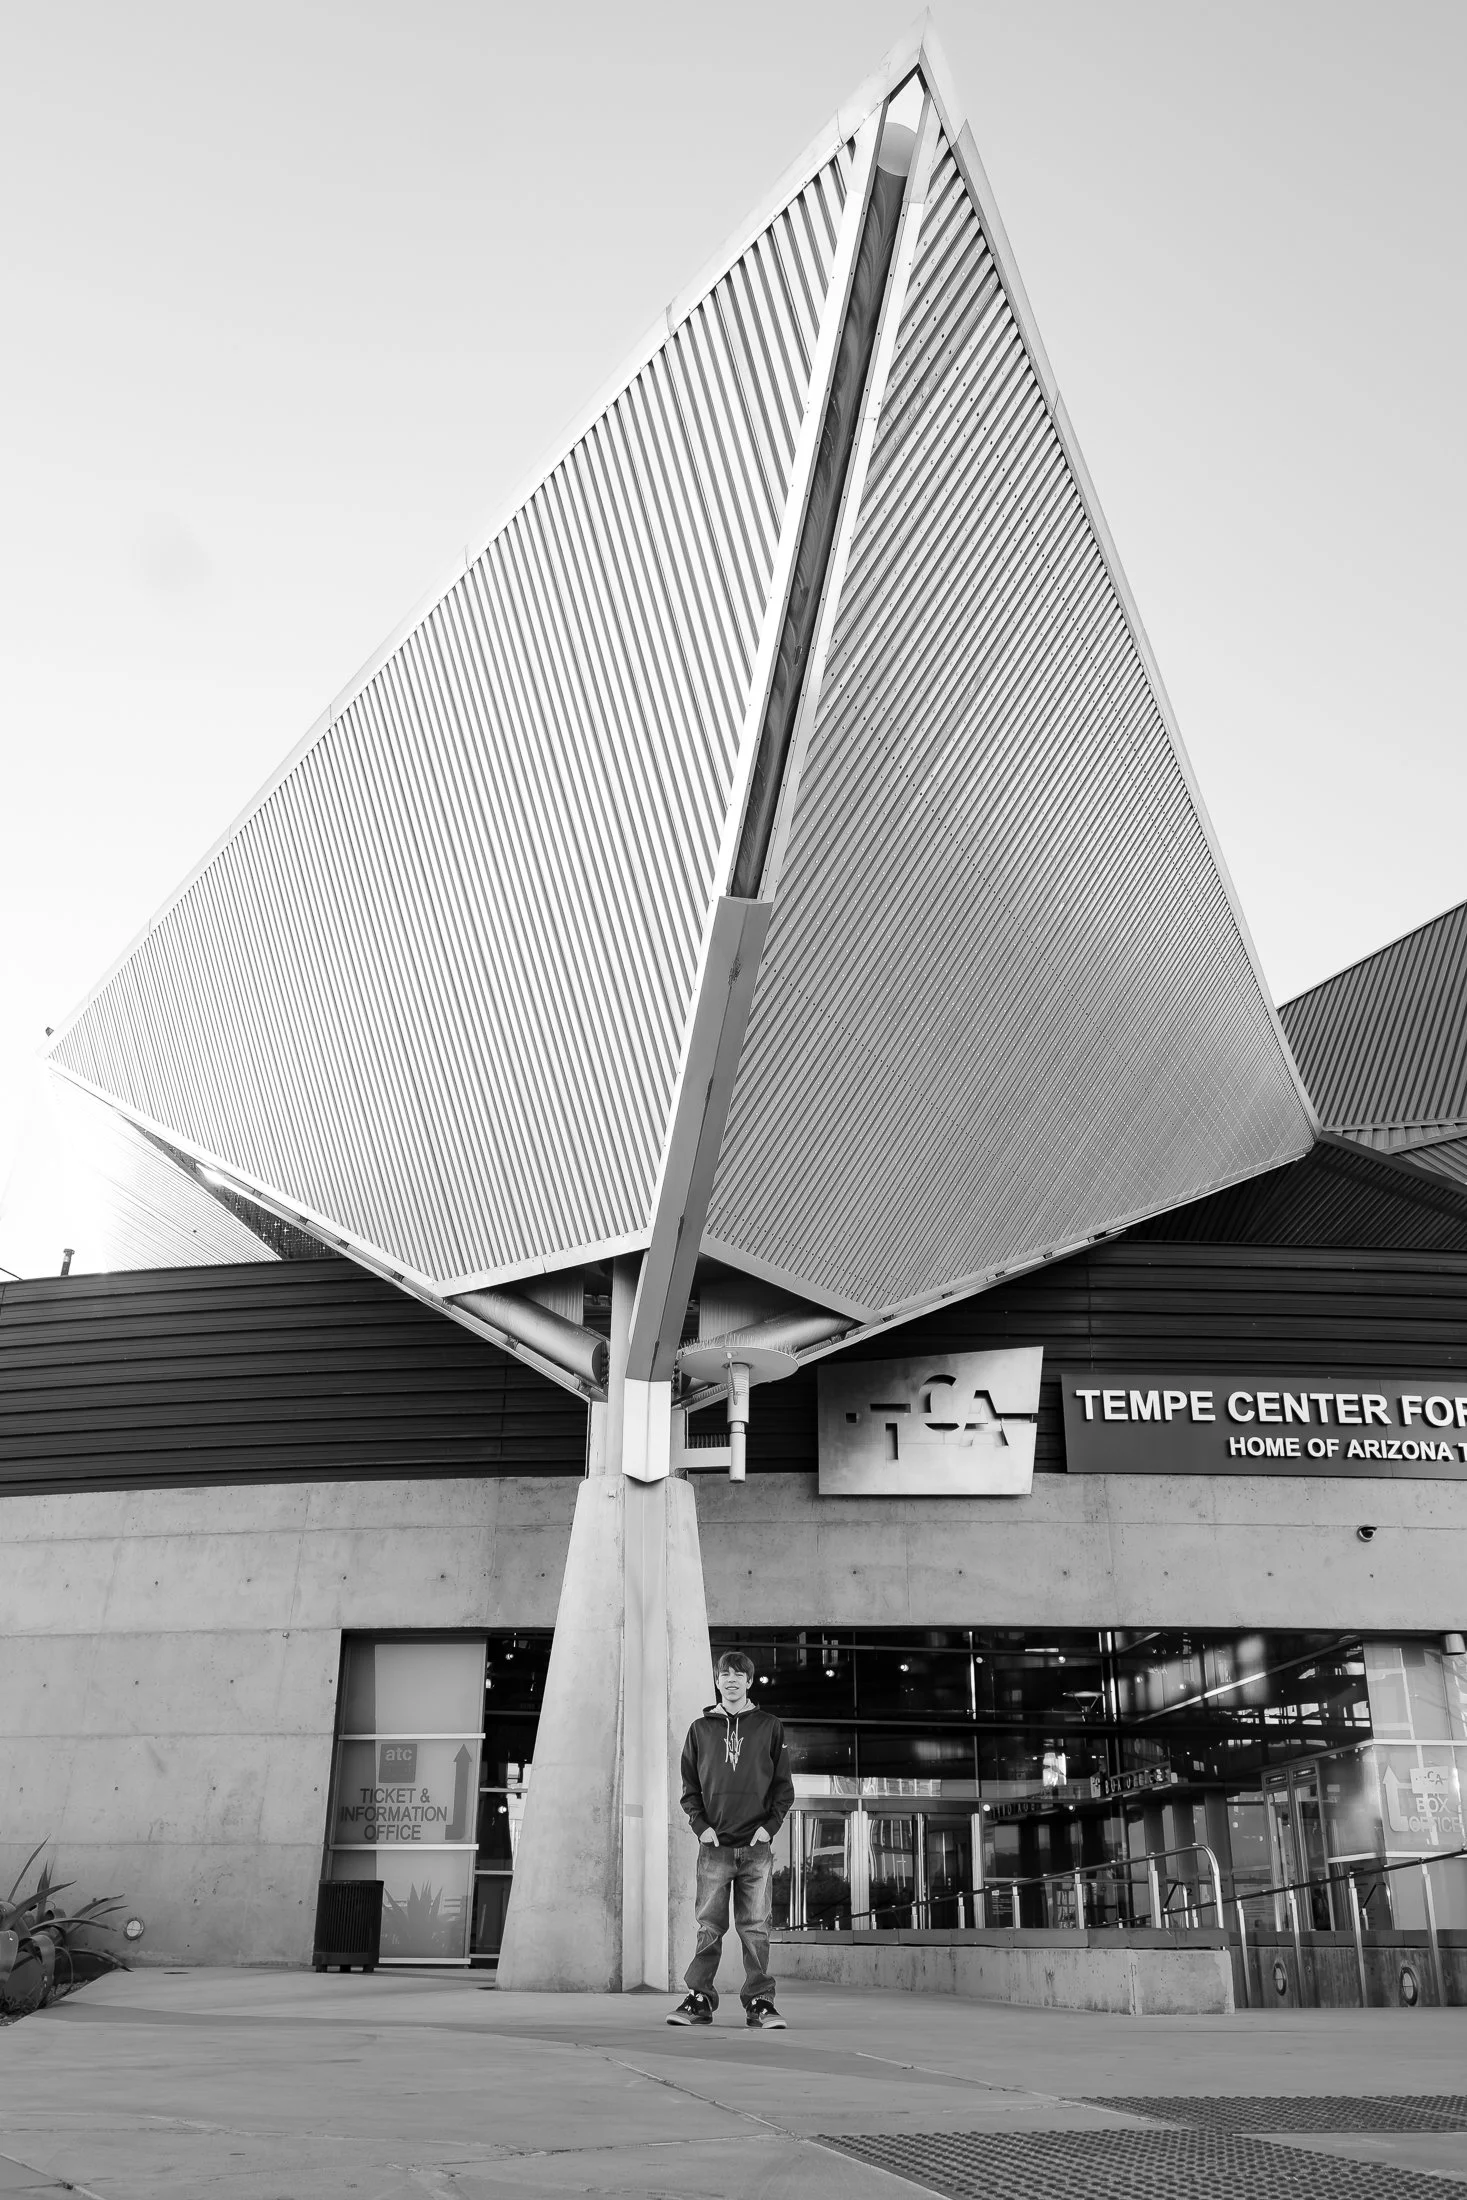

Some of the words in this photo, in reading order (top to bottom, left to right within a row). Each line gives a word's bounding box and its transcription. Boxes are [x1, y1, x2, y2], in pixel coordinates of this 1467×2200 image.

[1075, 1389, 1216, 1421] TEMPE
[1227, 1391, 1392, 1424] CENTER
[1229, 1436, 1301, 1457] HOME
[1307, 1437, 1339, 1458] OF
[1347, 1438, 1454, 1461] ARIZONA
[385, 1747, 412, 1760] atc
[360, 1788, 416, 1803] TICKET
[420, 1788, 430, 1803] &
[1416, 1797, 1450, 1813] BOX
[341, 1806, 447, 1822] INFORMATION
[364, 1825, 421, 1840] OFFICE
